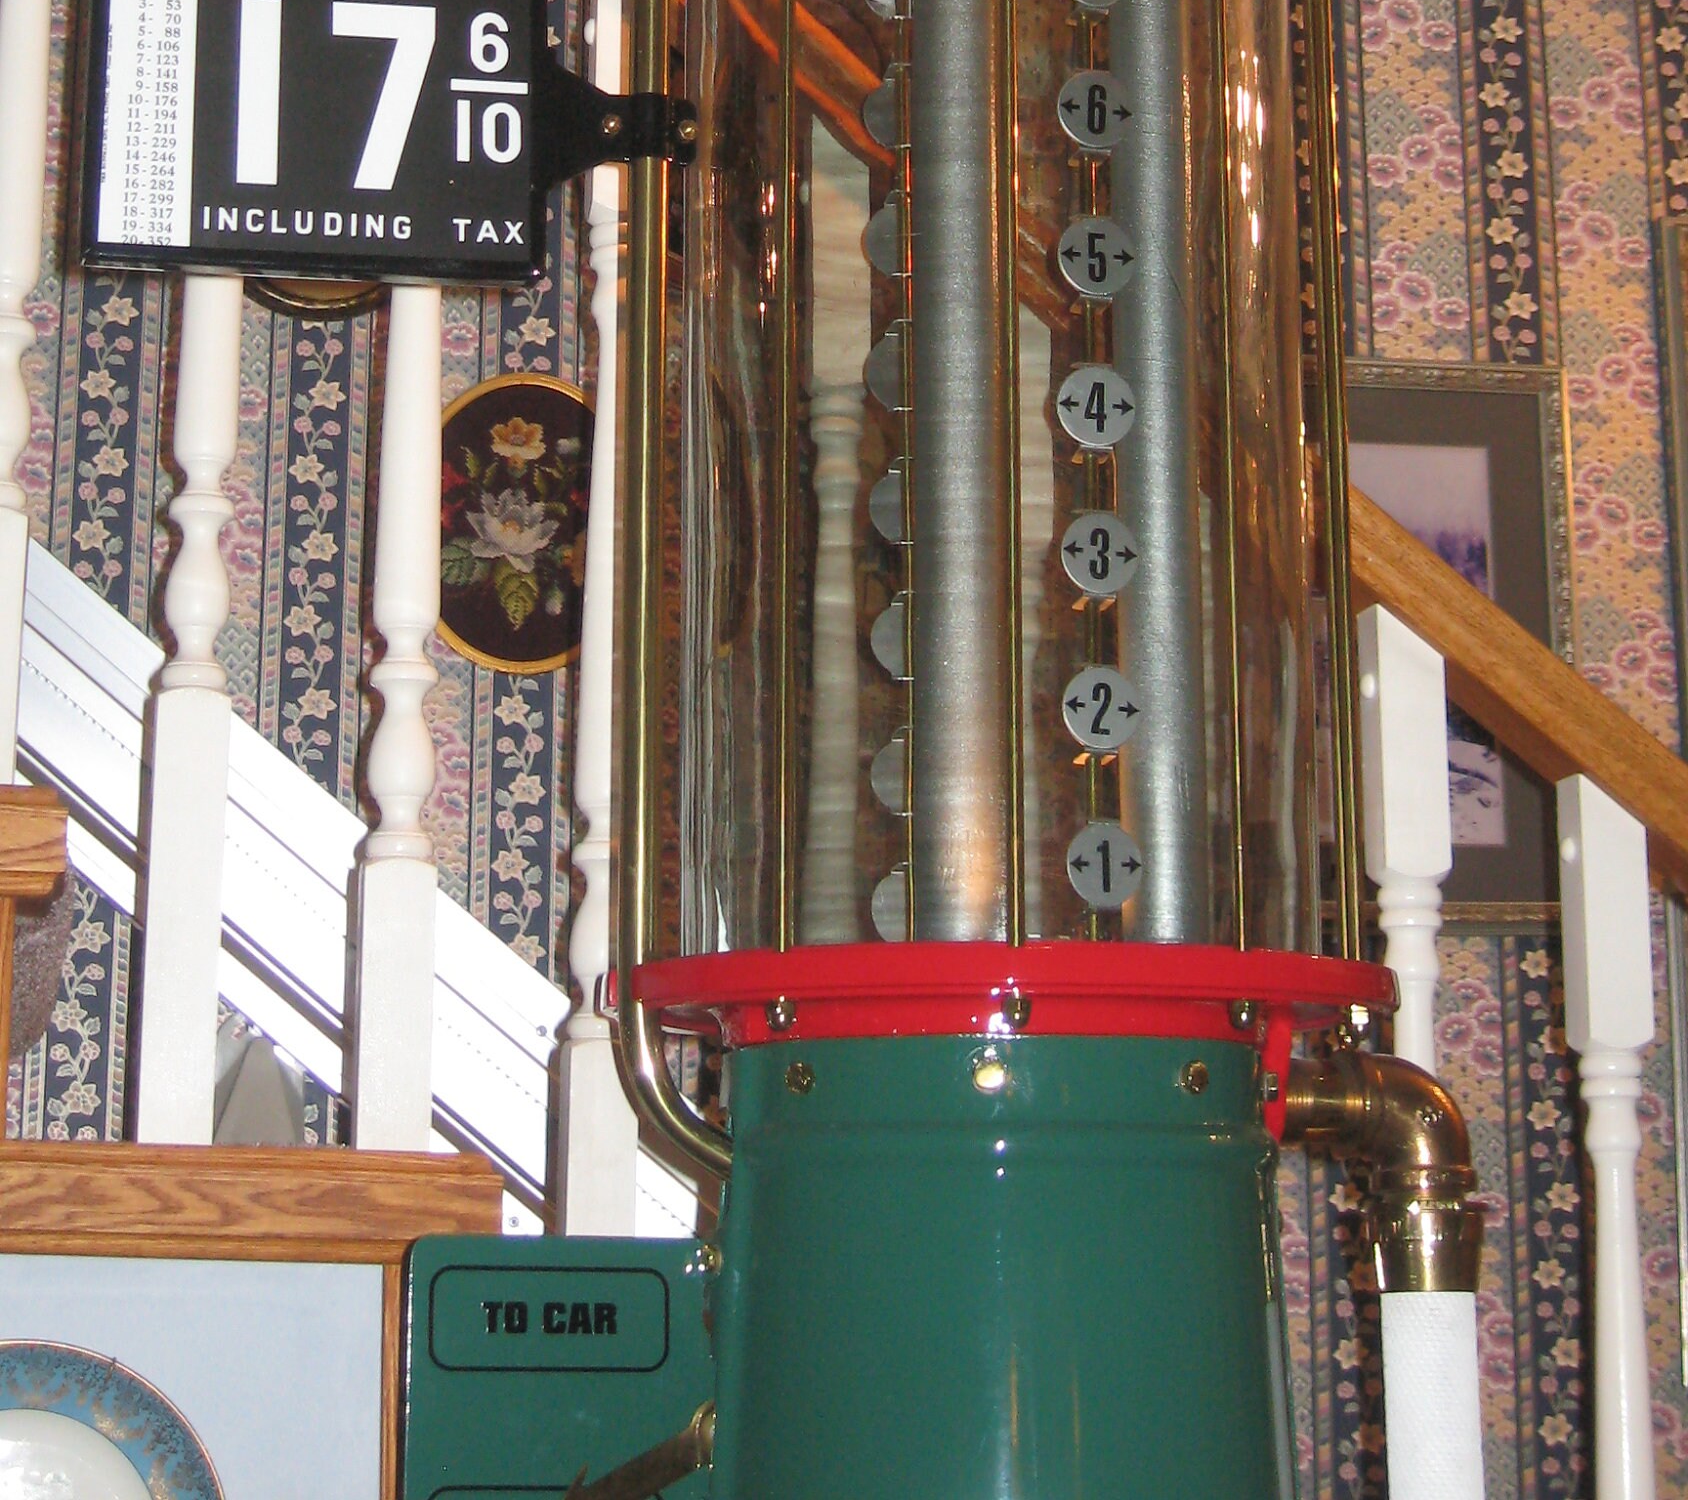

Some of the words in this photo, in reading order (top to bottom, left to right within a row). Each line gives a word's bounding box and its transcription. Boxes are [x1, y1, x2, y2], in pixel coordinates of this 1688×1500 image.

[165, 0, 182, 11] 53
[165, 14, 182, 25] 70
[164, 27, 181, 39] 88
[469, 11, 510, 74] 6
[455, 98, 523, 164] 10
[1087, 84, 1107, 134] 6
[202, 205, 412, 240] INCLUDING
[452, 218, 525, 246] TAX
[1087, 232, 1107, 282] 5
[1084, 382, 1107, 433] 4
[1089, 528, 1110, 580] 3
[1091, 682, 1112, 736] 2
[1096, 840, 1111, 893] 1
[481, 1301, 528, 1334] TO
[542, 1302, 617, 1335] CAR
